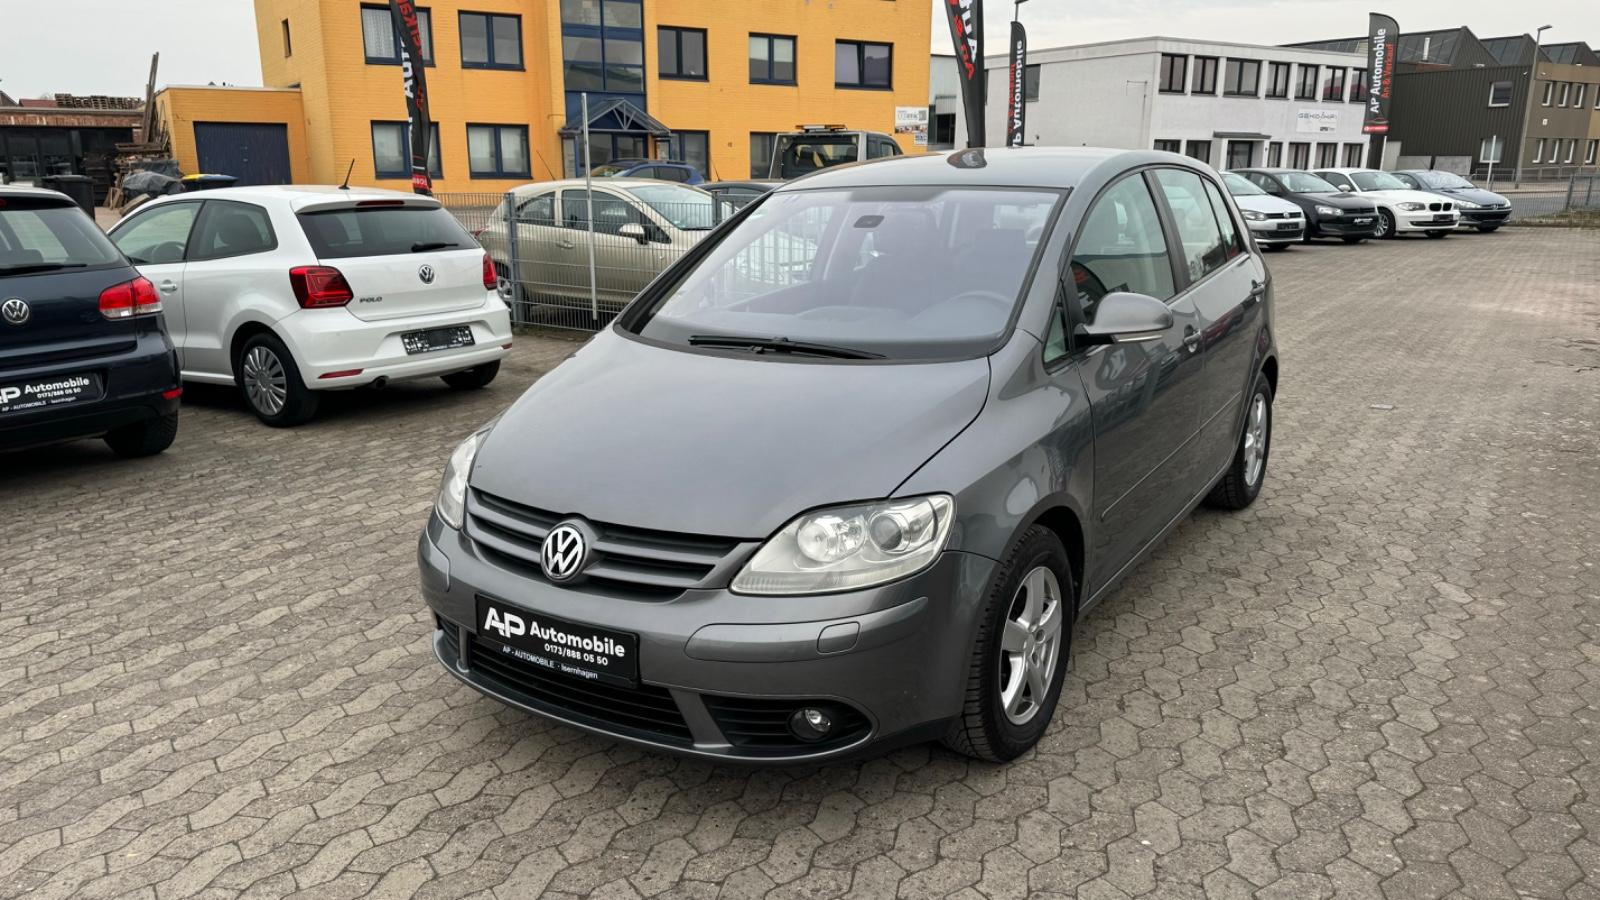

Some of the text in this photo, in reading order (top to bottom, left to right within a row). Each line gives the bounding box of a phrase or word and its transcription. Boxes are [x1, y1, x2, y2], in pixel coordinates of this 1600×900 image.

[1370, 28, 1387, 95] Automobile
[1370, 97, 1380, 113] AP
[24, 377, 90, 394] Automobile
[484, 607, 625, 657] AP Automobile
[502, 645, 511, 653] AP
[515, 650, 555, 669] AUTOMOBILE
[561, 663, 598, 679] Isernhagen
[544, 643, 608, 666] 0173/888 05 50
